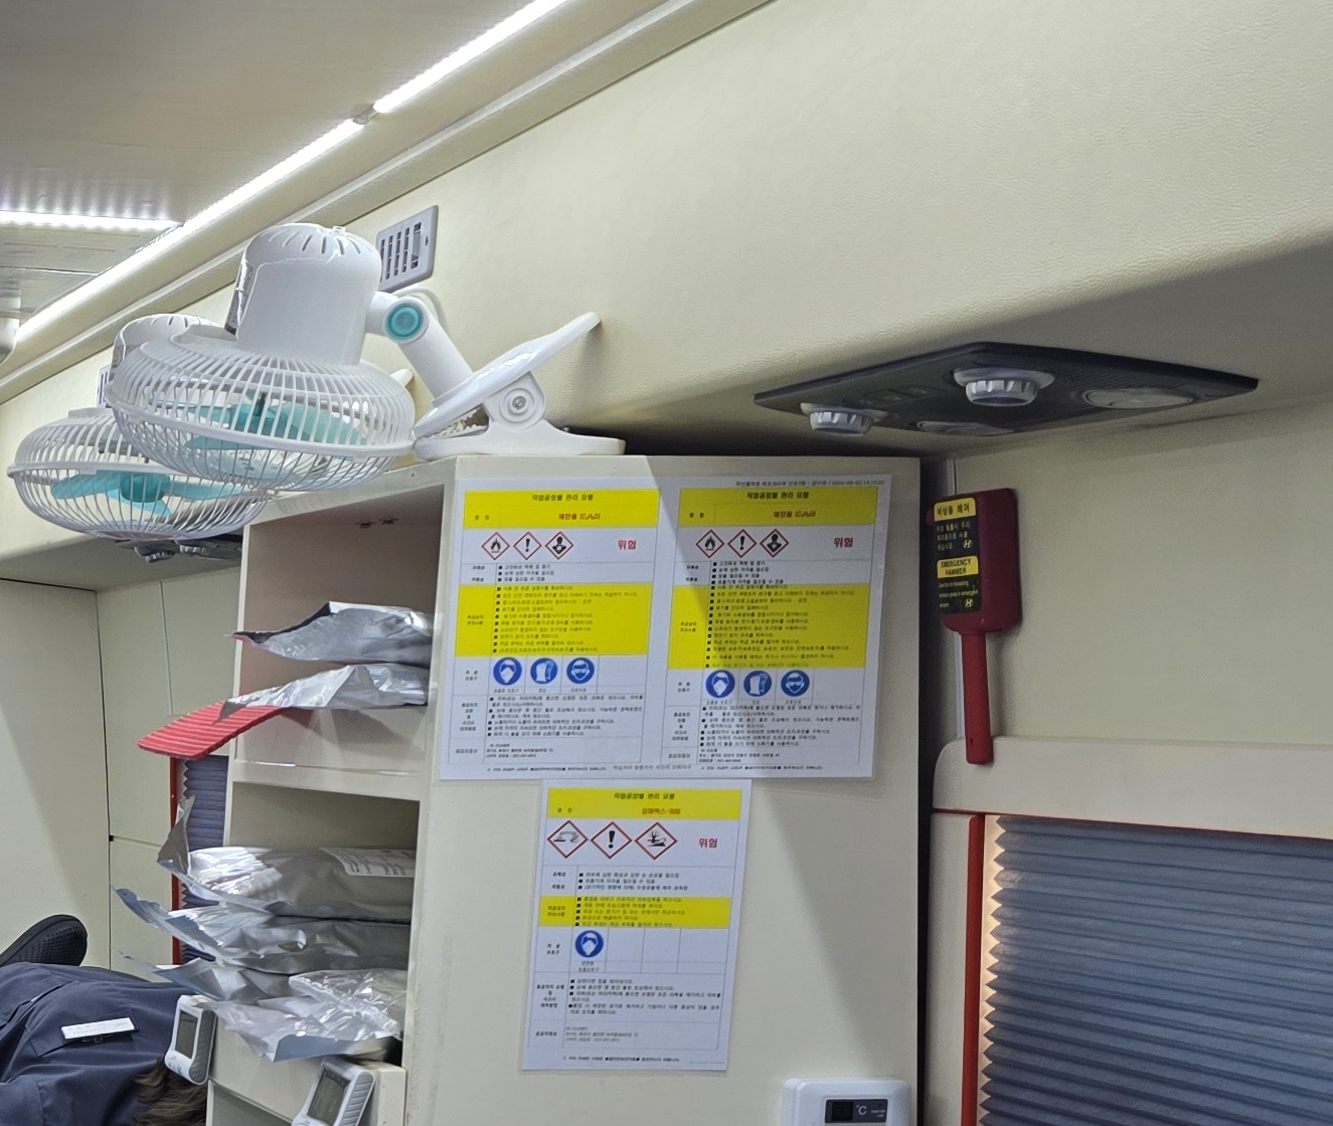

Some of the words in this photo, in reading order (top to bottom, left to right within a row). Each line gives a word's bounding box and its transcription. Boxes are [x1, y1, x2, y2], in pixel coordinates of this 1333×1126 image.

[617, 539, 637, 550] 위험
[833, 537, 854, 548] 위험
[941, 558, 972, 568] EMERGENCY
[698, 838, 718, 848] 위험
